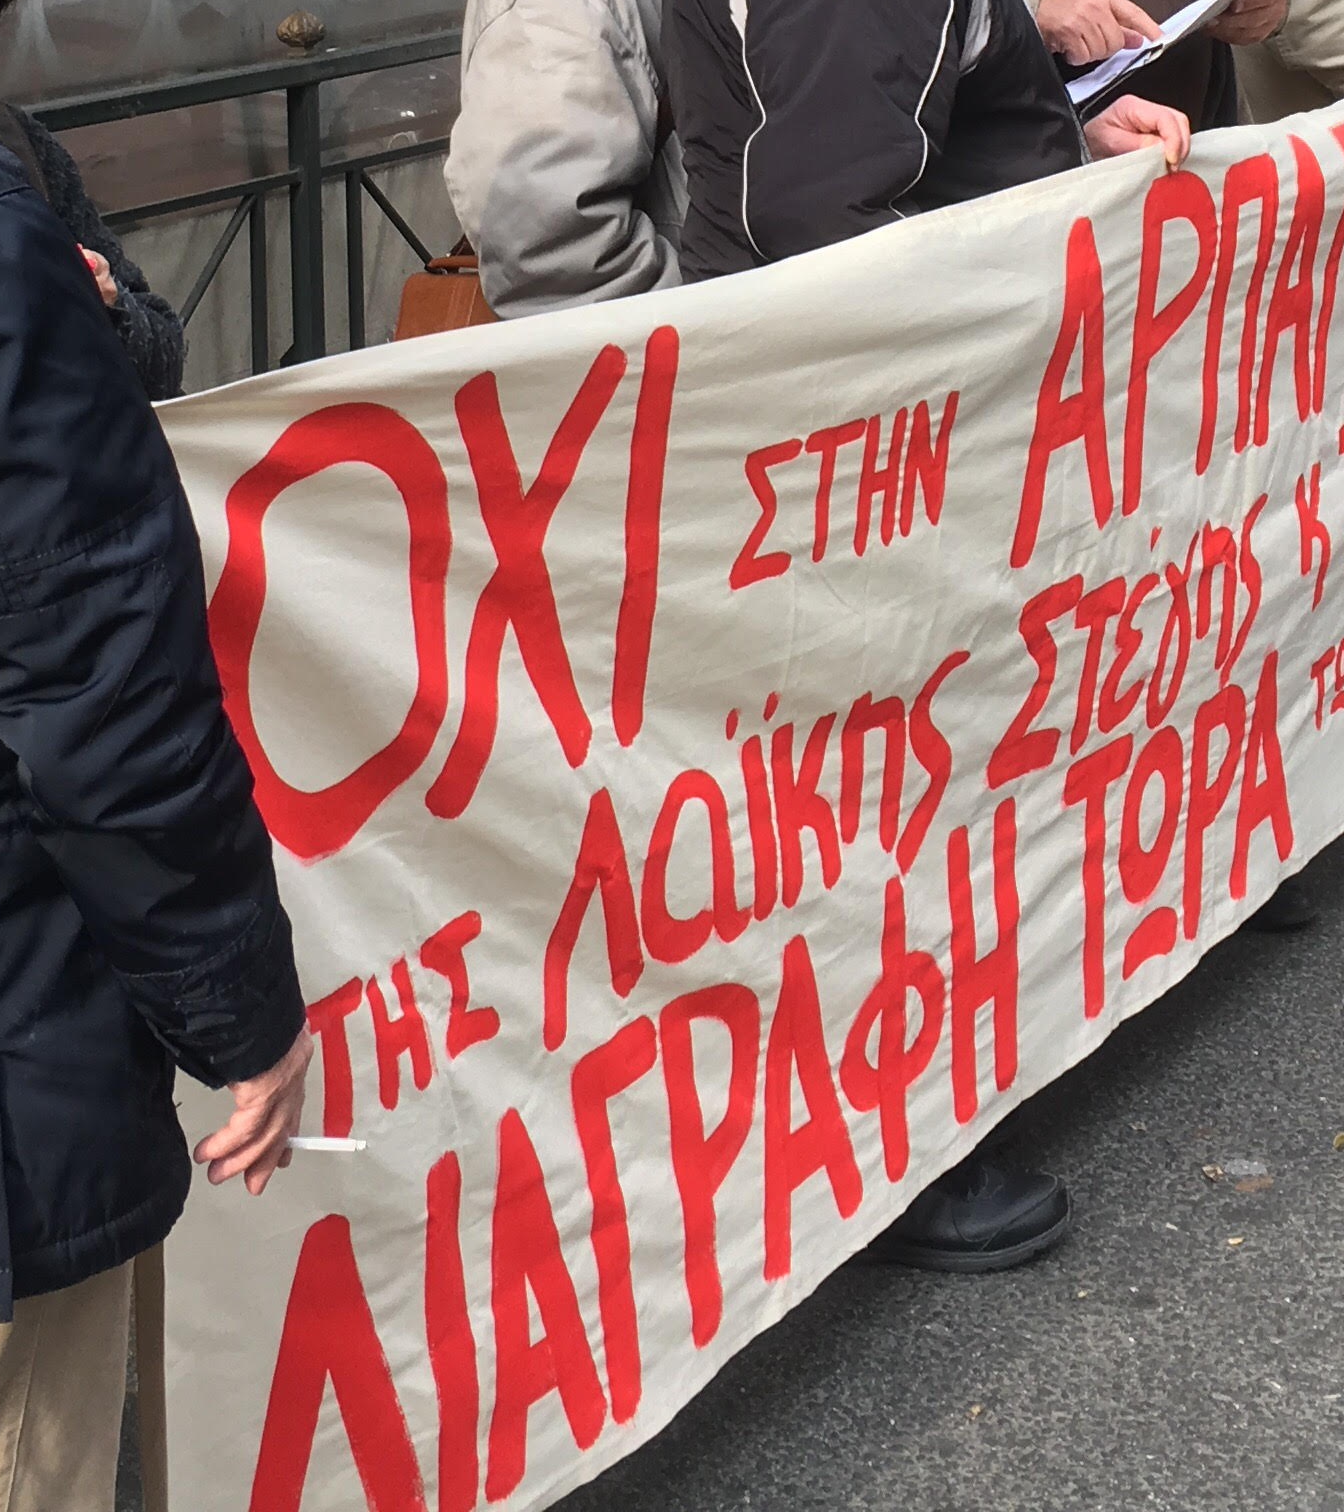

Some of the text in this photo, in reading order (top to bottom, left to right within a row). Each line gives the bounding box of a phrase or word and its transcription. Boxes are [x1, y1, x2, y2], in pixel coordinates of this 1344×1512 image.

[207, 324, 680, 866] ΟΧΙ
[728, 389, 961, 591] ΣΤΗΝ
[1061, 650, 1295, 1022] ΤΩΡΑ
[307, 910, 500, 1137] ΤΗΣ
